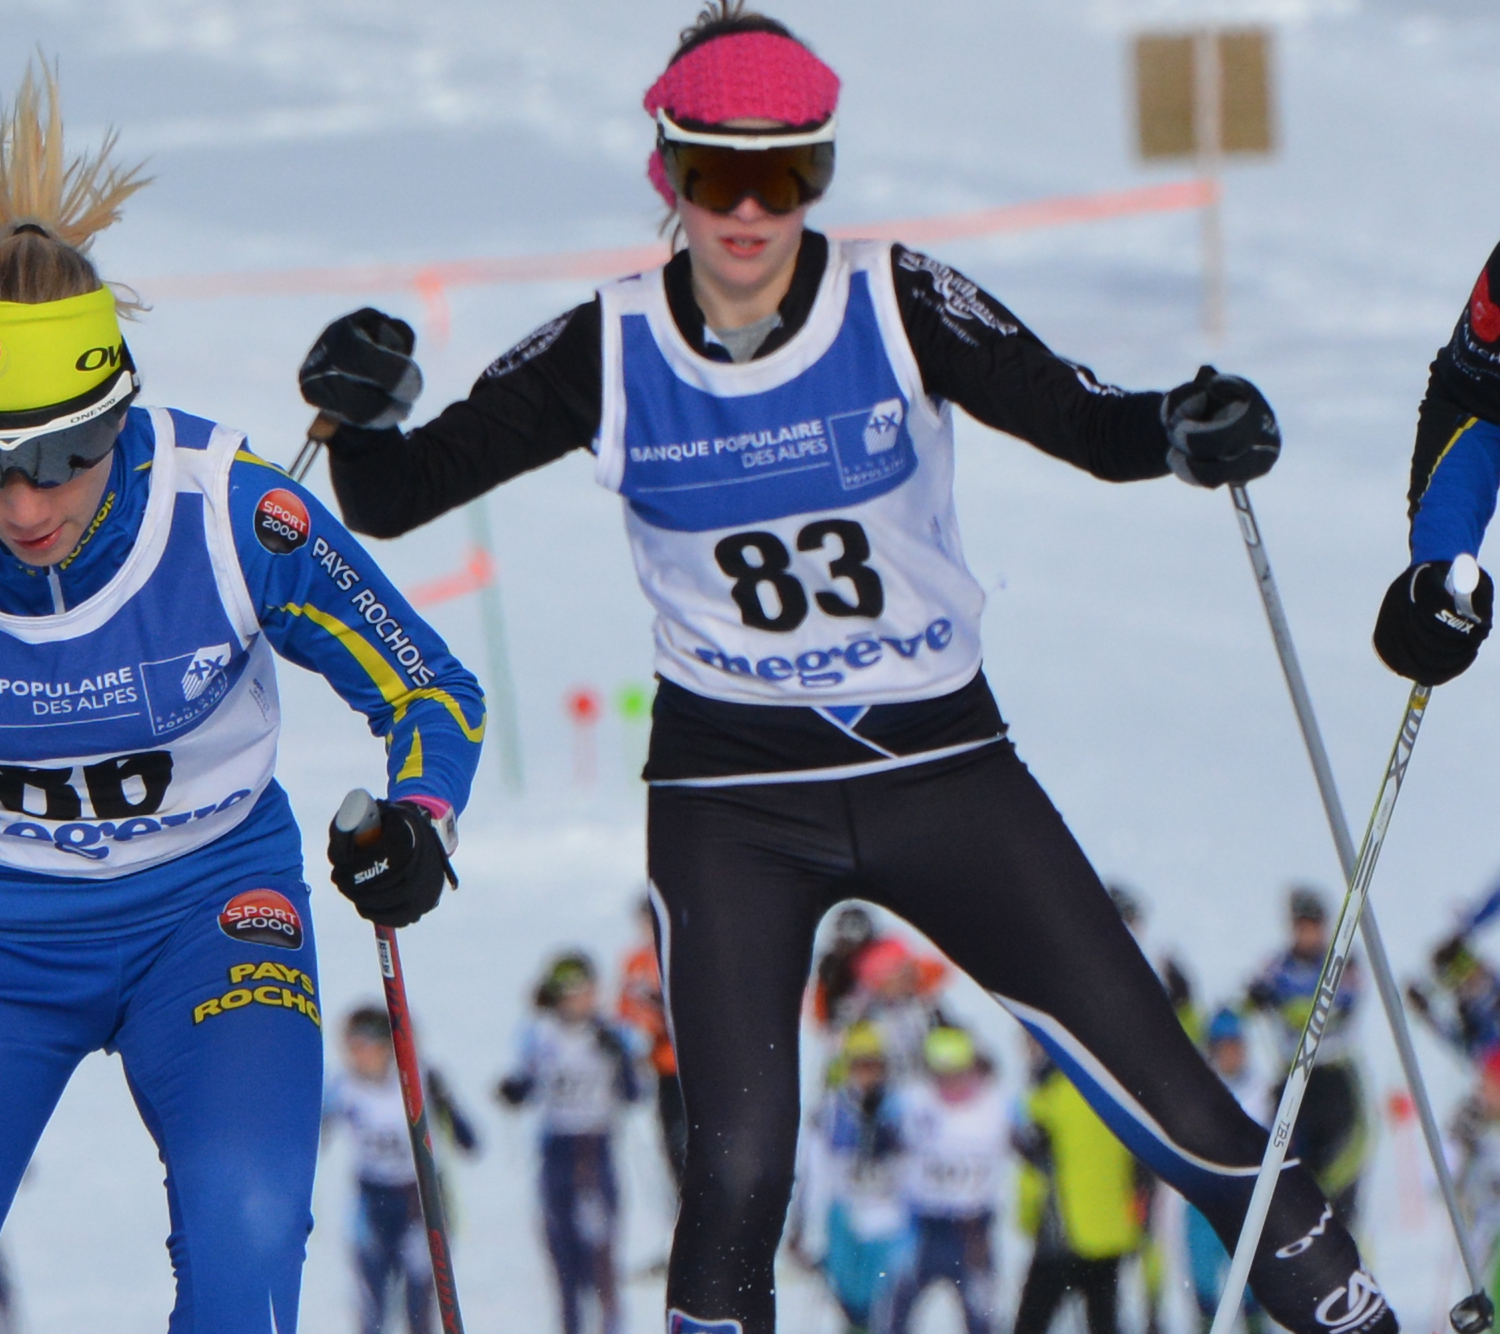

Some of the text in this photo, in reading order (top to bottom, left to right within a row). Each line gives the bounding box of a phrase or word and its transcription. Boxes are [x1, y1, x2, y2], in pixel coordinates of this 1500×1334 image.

[630, 420, 825, 463] BANQUE POPULAIRE
[741, 438, 829, 469] DES ALPES
[262, 515, 299, 542] 2000
[263, 500, 307, 532] SPORT
[714, 519, 885, 633] 83
[312, 537, 436, 687] PAYS ROCHOIS
[1435, 608, 1475, 635] swix
[32, 686, 139, 717] DES ALPES
[354, 858, 390, 885] swix
[226, 906, 297, 924] SPORT
[236, 917, 296, 937] 2000
[229, 961, 316, 996] PAYS
